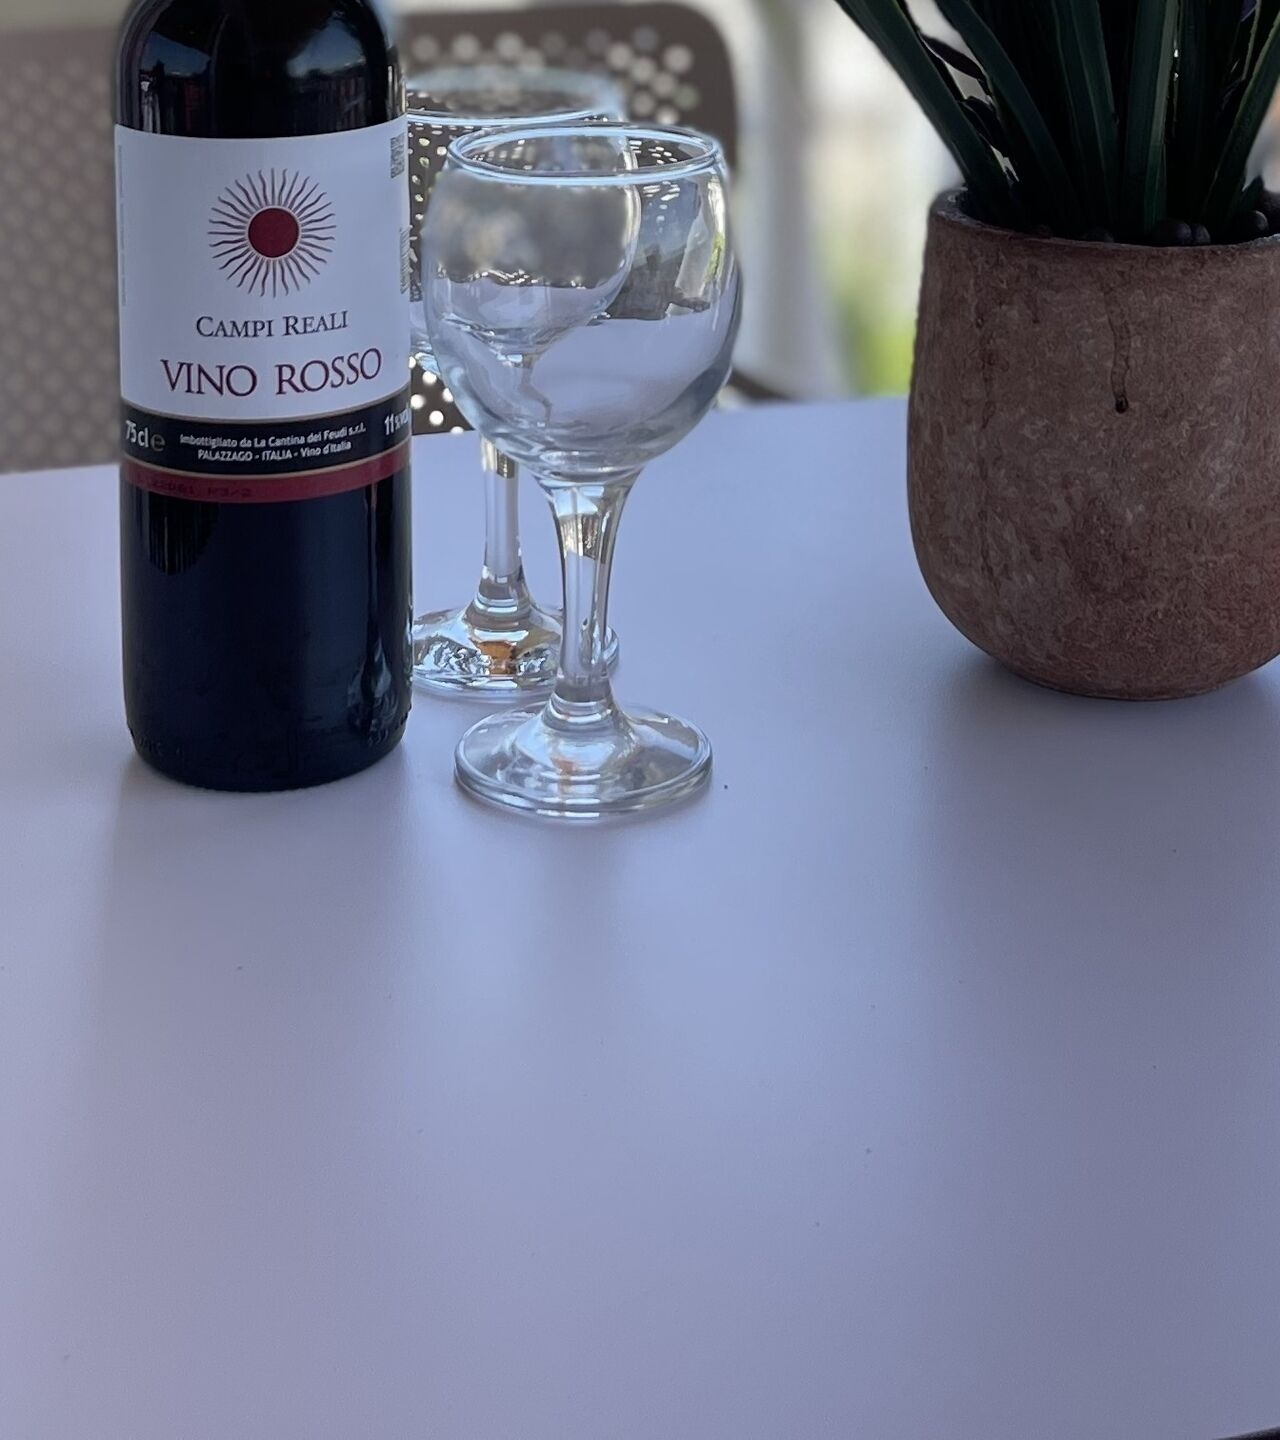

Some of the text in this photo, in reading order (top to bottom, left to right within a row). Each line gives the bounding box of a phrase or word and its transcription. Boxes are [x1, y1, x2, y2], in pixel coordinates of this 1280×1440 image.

[196, 310, 349, 338] CAMPI REALI
[160, 348, 382, 397] VINO ROSSO
[239, 437, 252, 448] da
[253, 437, 266, 448] La
[268, 435, 305, 447] Cantina
[307, 431, 322, 444] dei
[323, 426, 347, 440] Feudi
[198, 449, 253, 462] PALAZZAGO
[261, 449, 293, 461] ITALIA
[300, 447, 321, 458] Vino
